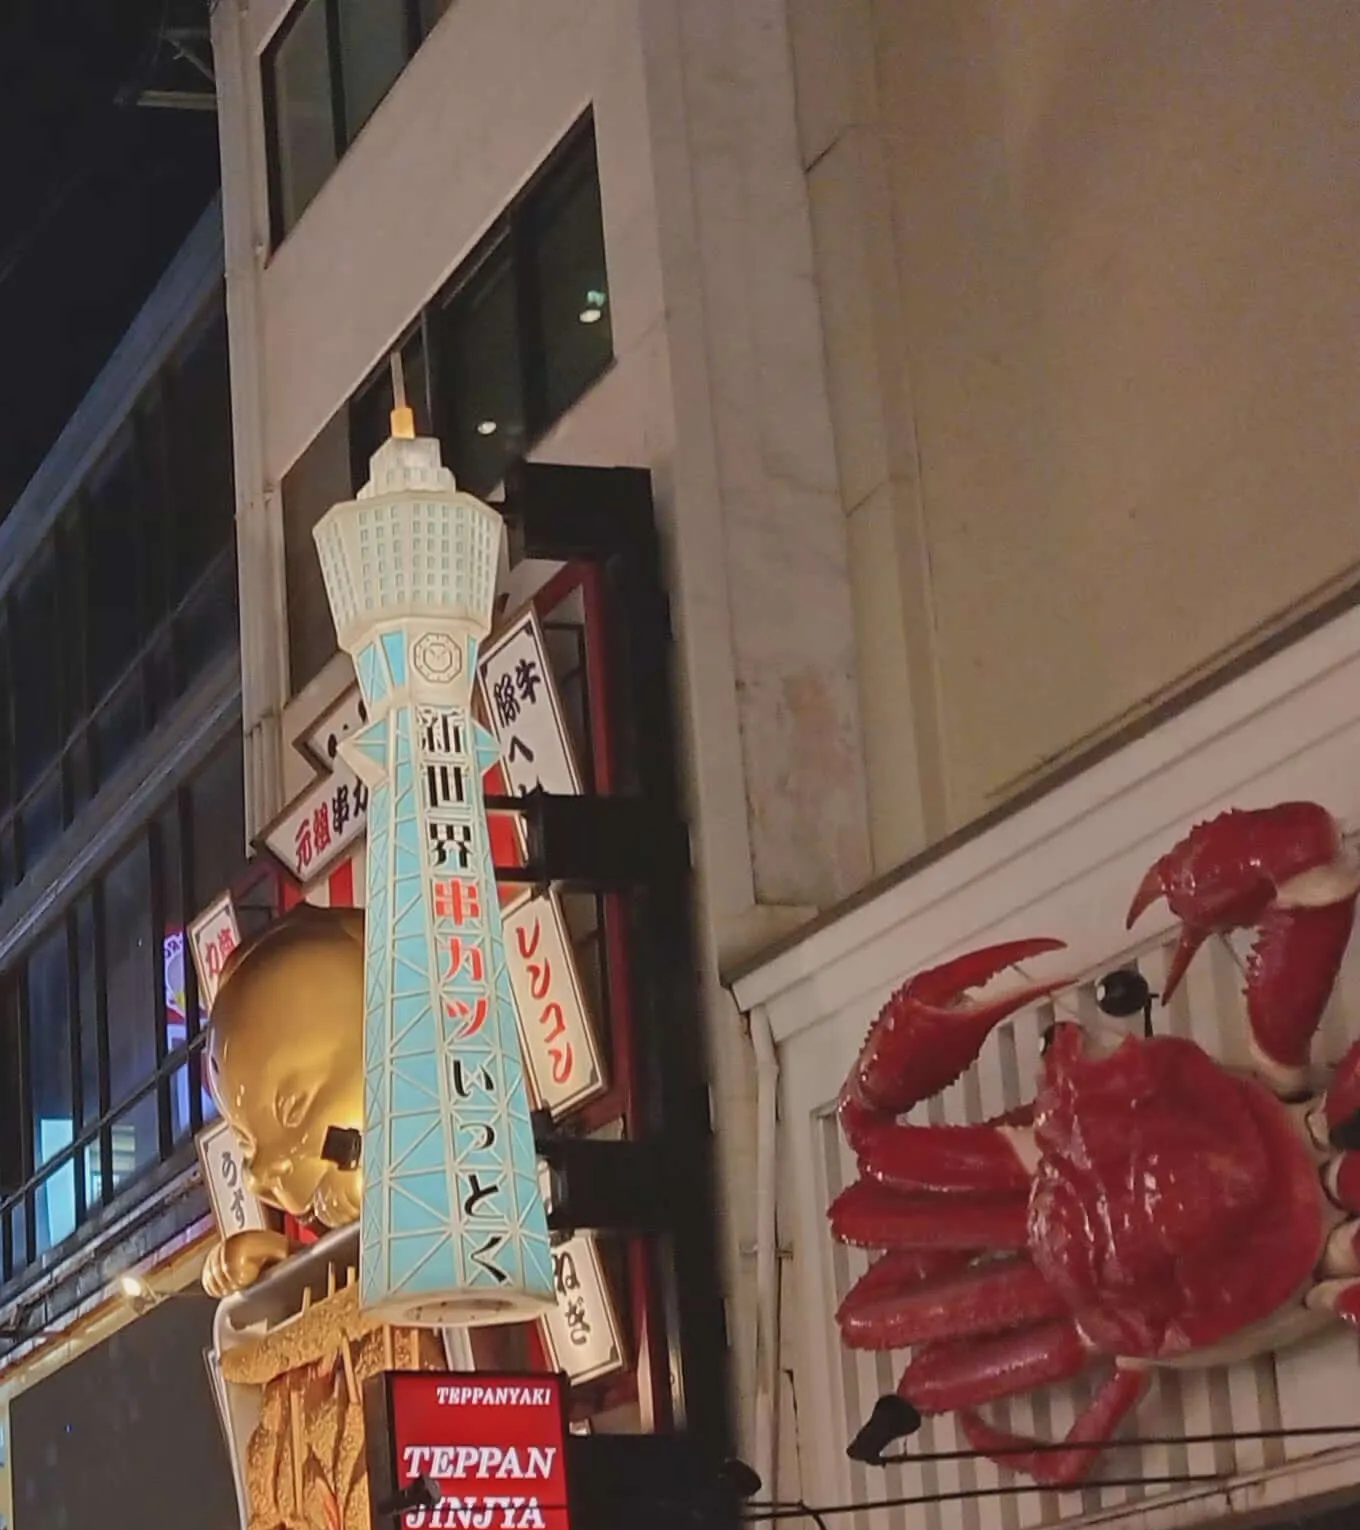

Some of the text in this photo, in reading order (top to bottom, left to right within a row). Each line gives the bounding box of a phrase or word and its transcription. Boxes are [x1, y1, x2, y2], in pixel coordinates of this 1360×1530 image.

[418, 706, 508, 1284] 新世界串カツいっとく
[515, 916, 573, 1084] レンコン
[437, 1387, 551, 1406] TEPPANYAKI
[403, 1446, 556, 1479] TEPPAN
[406, 1496, 545, 1530] JINJYA
